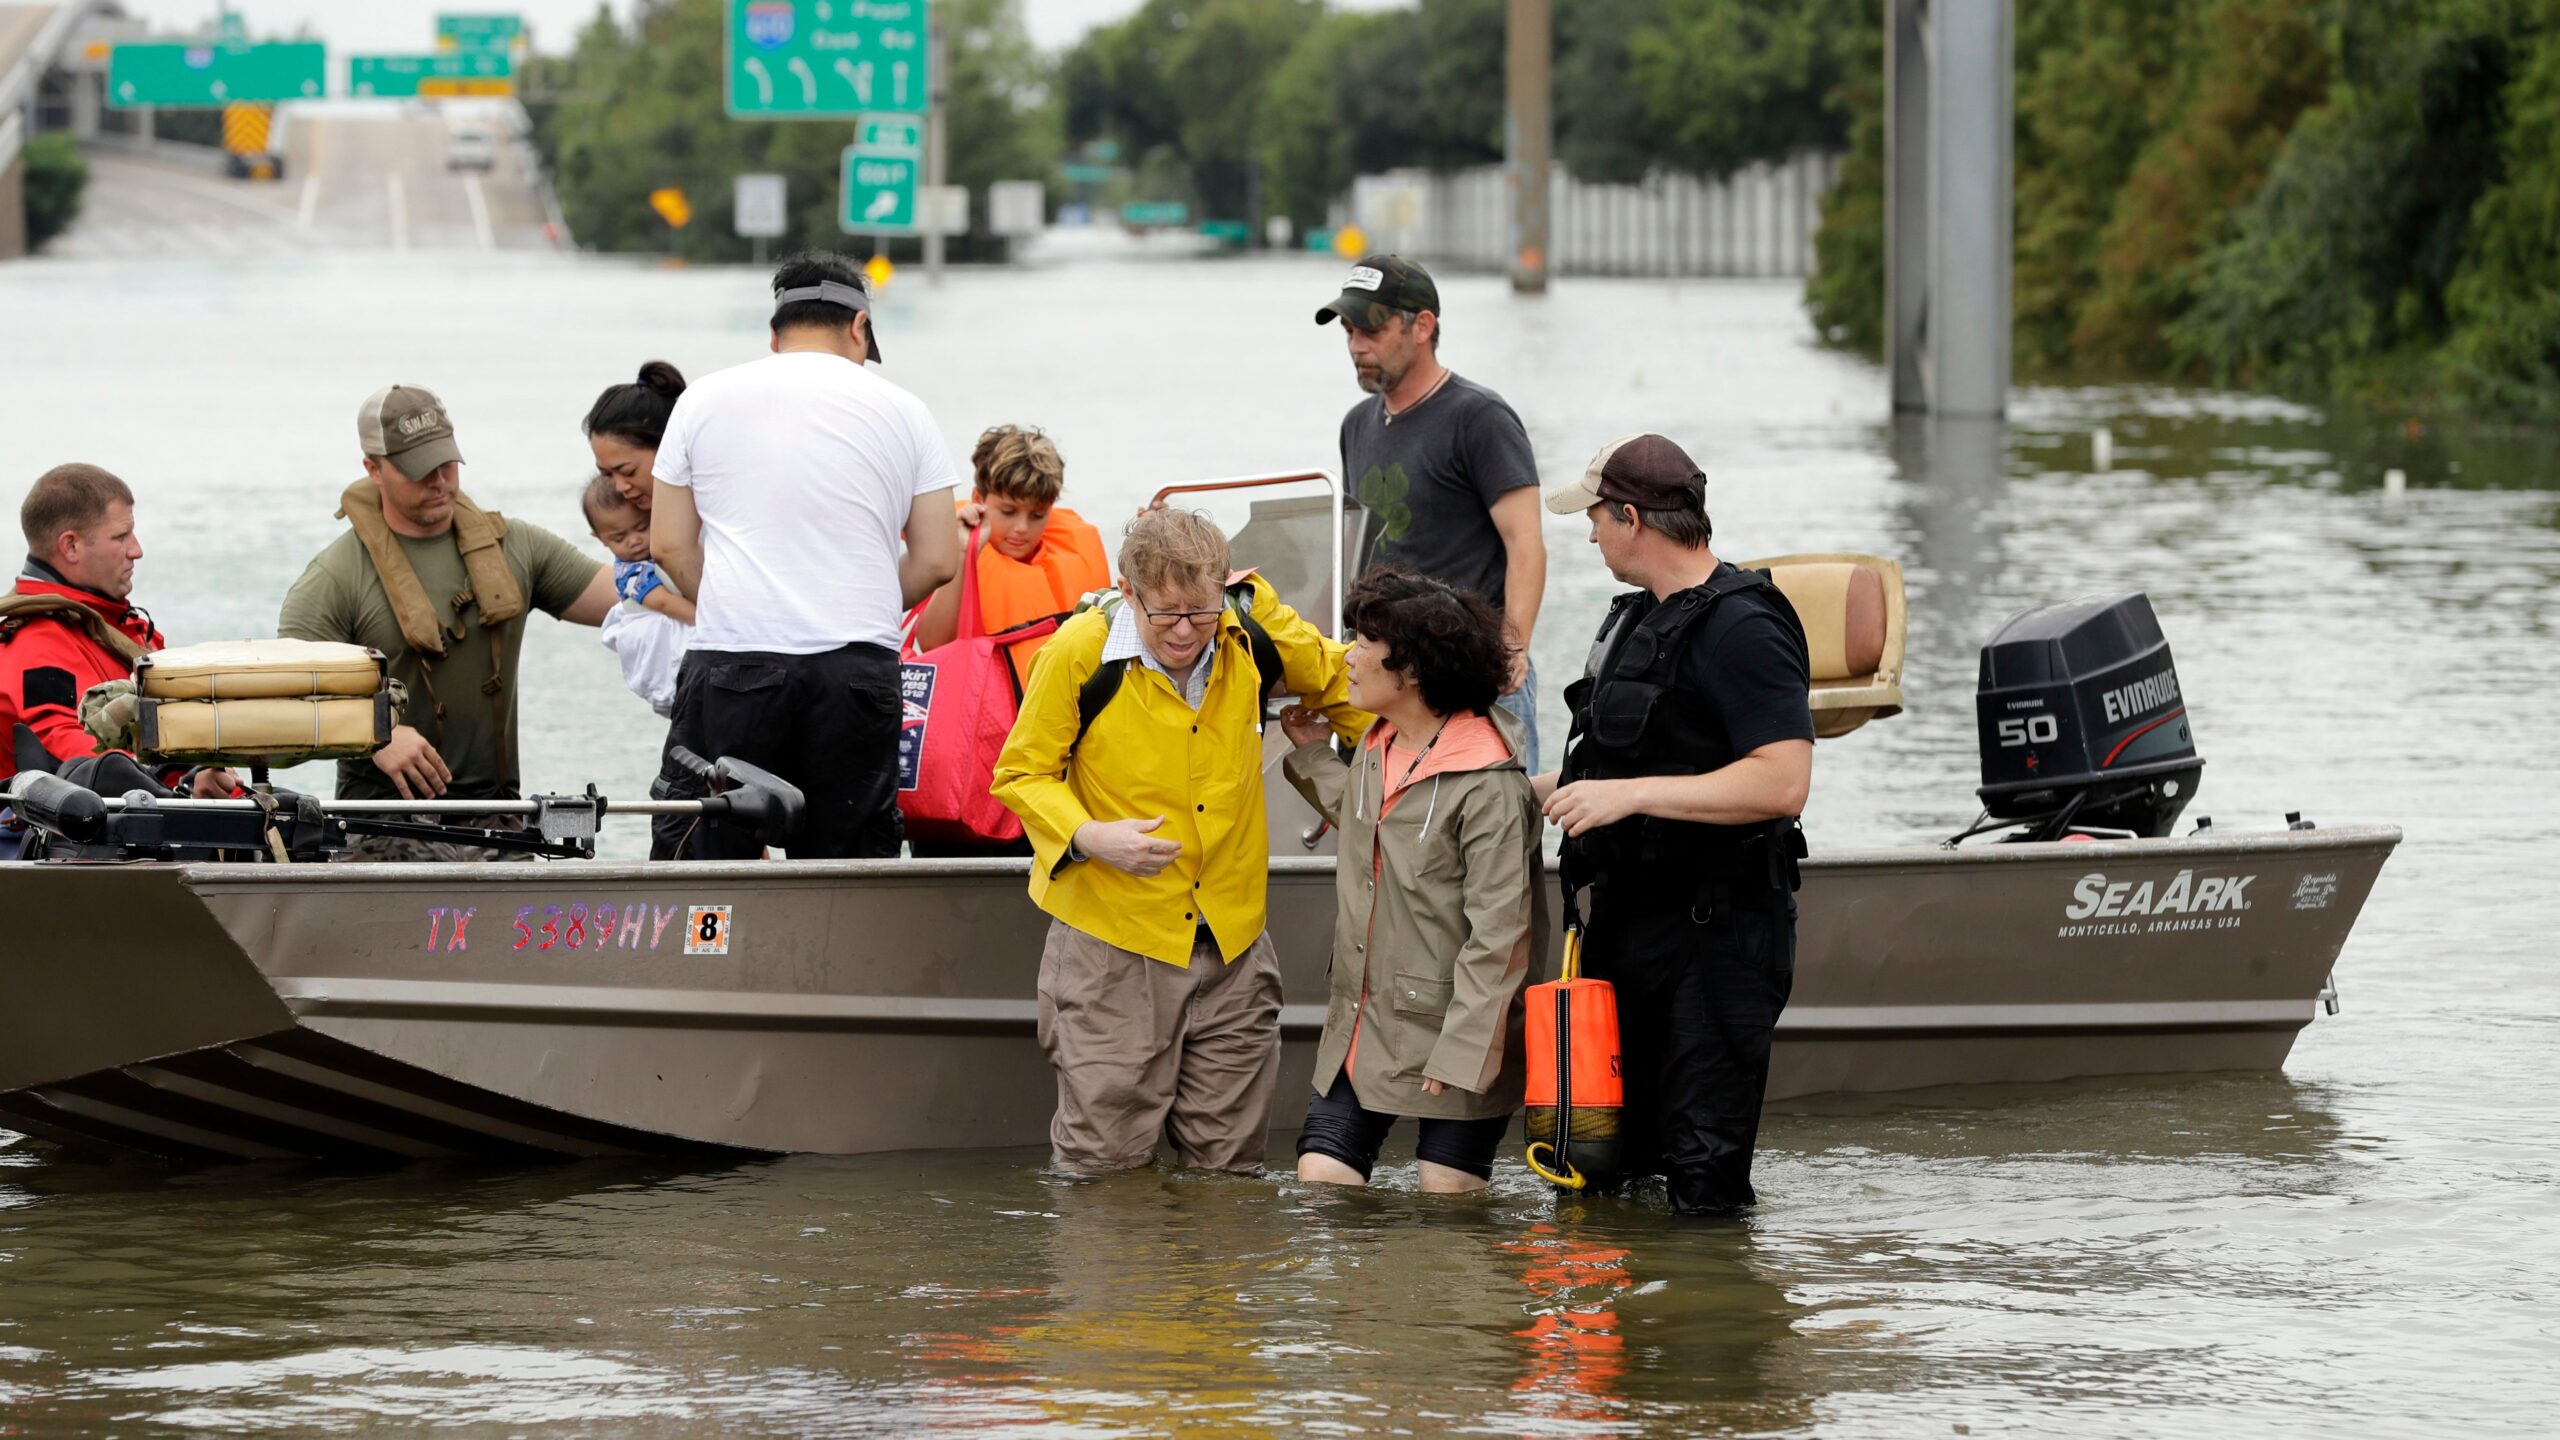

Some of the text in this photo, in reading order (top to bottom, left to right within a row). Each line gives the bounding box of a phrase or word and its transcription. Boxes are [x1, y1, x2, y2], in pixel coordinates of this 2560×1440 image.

[902, 690, 925, 698] 012
[2007, 699, 2044, 711] EVINRUDE
[2102, 668, 2179, 724] EVINRUDE
[1999, 714, 2058, 748] 50
[426, 902, 678, 952] TX 5389HY
[701, 913, 717, 941] 8
[2058, 916, 2241, 938] MONTICELLO, ARKANSAS USA
